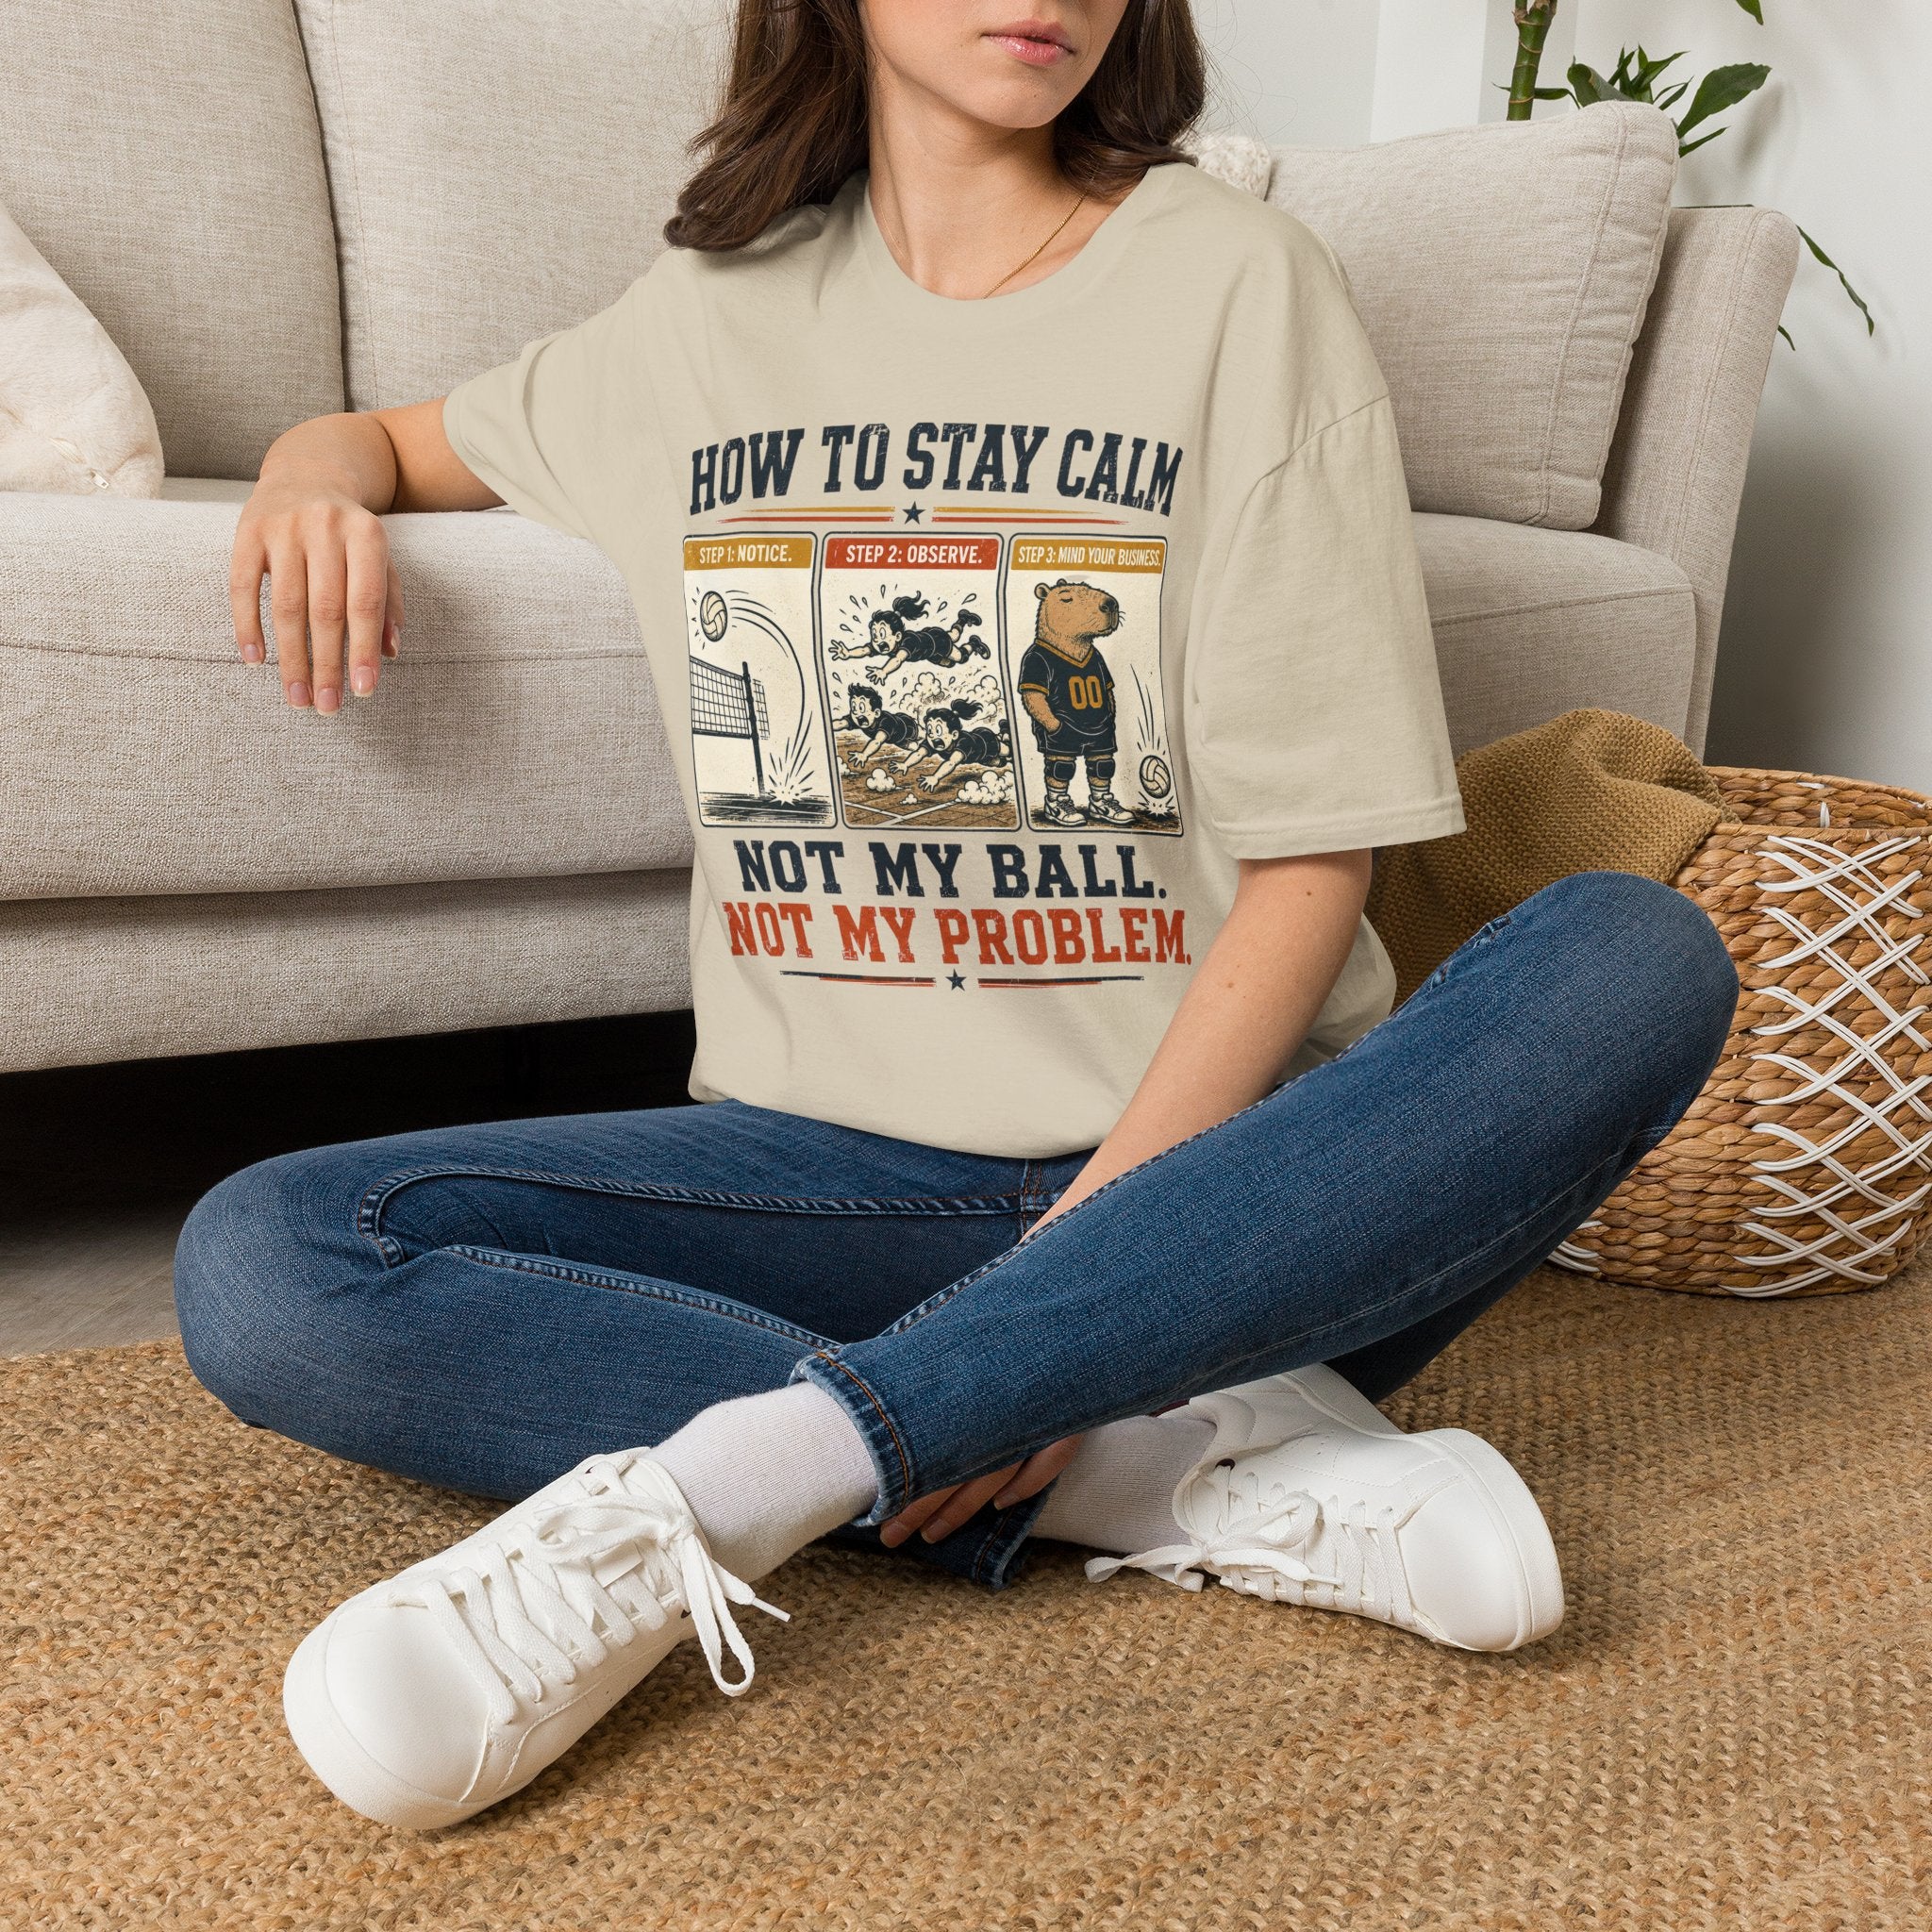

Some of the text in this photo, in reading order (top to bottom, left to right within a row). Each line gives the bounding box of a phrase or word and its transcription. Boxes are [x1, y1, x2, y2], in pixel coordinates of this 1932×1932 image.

[690, 422, 1184, 517] HOW TO STAY CALM
[699, 544, 792, 564] STEP 1: NOTICE.
[846, 544, 982, 564] STEP 2: OBSERVE.
[1018, 545, 1161, 567] STEP 3: MIND YOUR BUSINESS.
[1068, 675, 1103, 710] 00
[733, 840, 1167, 899] NOT MY BALL.
[722, 902, 1192, 966] NOT MY PROBLEM.
